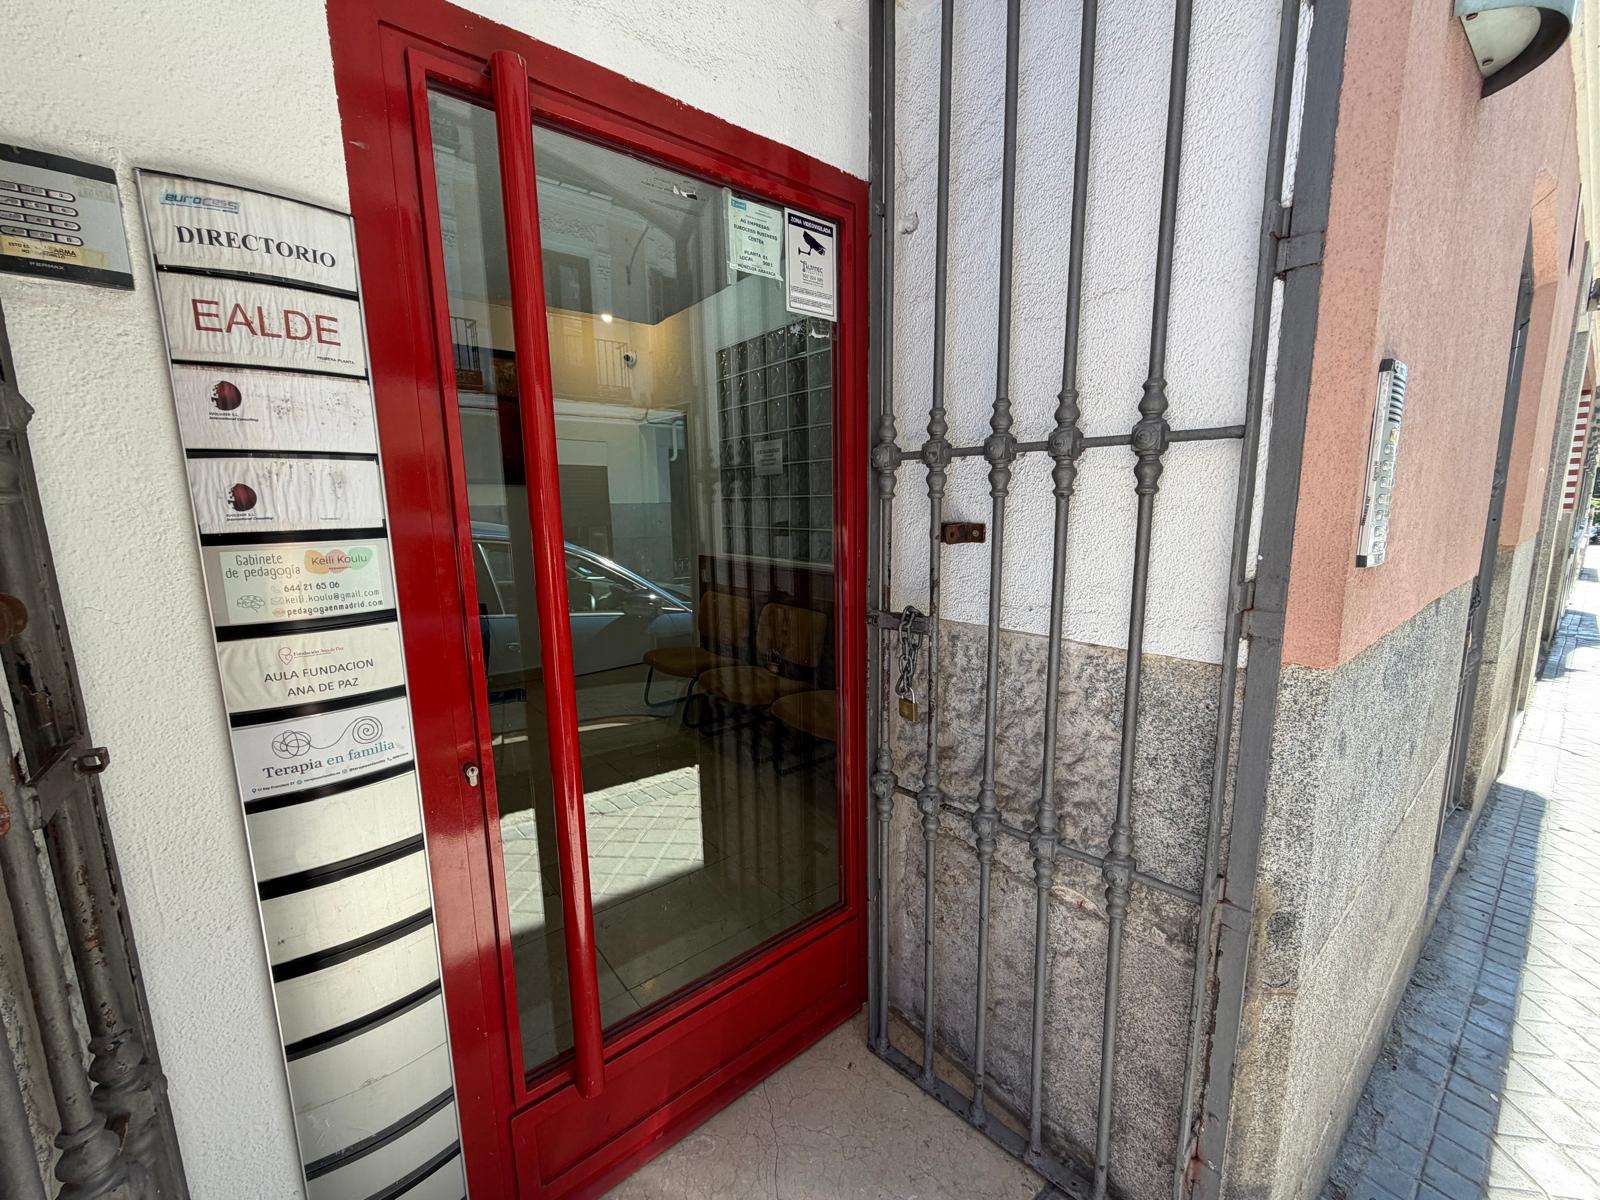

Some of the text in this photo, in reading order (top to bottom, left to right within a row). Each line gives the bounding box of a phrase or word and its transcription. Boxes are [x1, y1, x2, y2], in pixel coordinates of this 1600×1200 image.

[790, 216, 831, 234] ZONA VIDEOVIGILADA
[757, 230, 778, 241] BUSINESS
[175, 225, 336, 267] DIRECTORIO
[191, 298, 341, 346] EALDE
[235, 553, 283, 566] Gabinete
[337, 554, 368, 564] Koulu
[225, 564, 301, 581] de pedagogía
[283, 584, 300, 592] 644
[303, 583, 313, 591] 21
[329, 581, 340, 589] 06
[287, 600, 384, 617] pedagogaenmadrid.com
[264, 658, 374, 683] AULA FUNDACION
[287, 677, 359, 697] ANA DE PAZ
[262, 740, 395, 779] Terapia en familia
